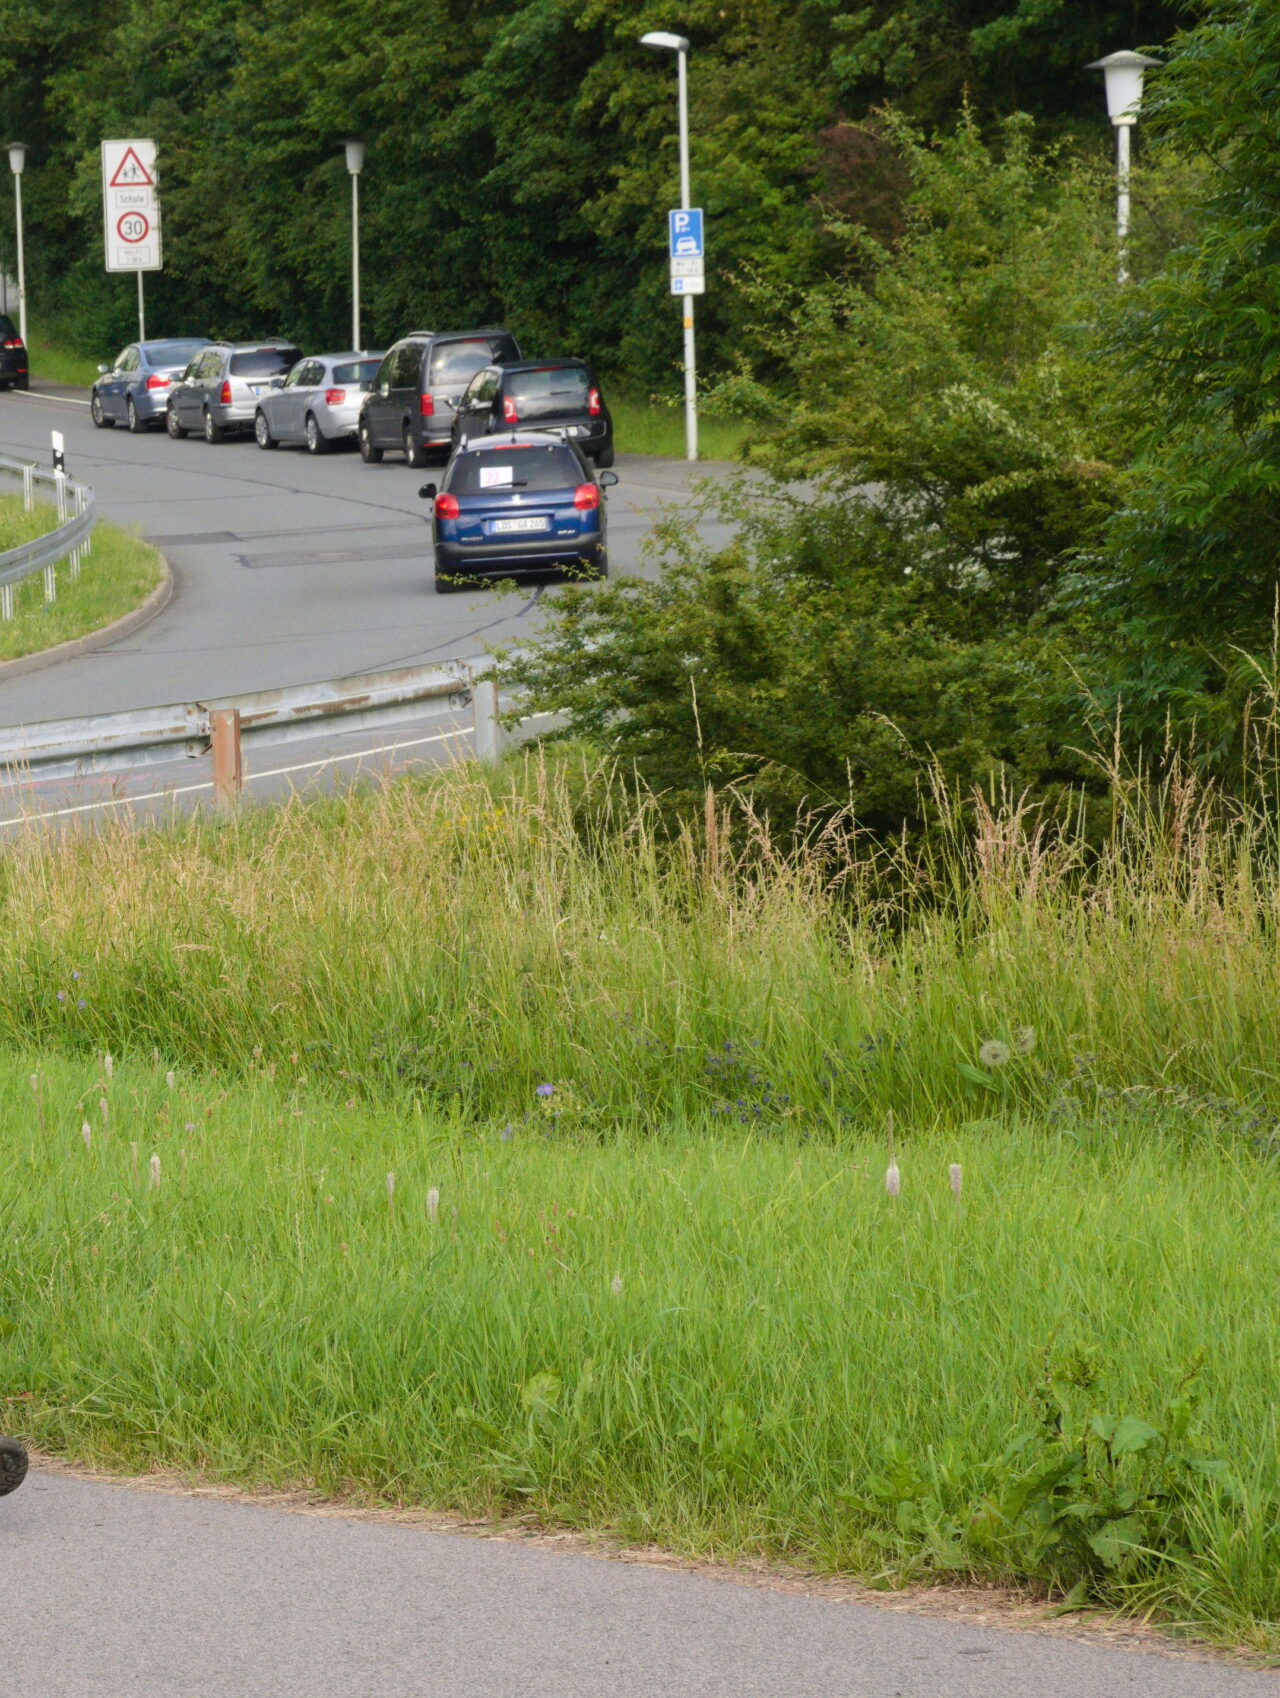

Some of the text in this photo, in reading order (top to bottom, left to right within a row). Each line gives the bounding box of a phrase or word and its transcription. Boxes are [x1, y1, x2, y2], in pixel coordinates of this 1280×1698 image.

[120, 194, 144, 203] Schule
[124, 221, 142, 235] 30
[675, 213, 689, 233] P
[485, 471, 500, 485] 22
